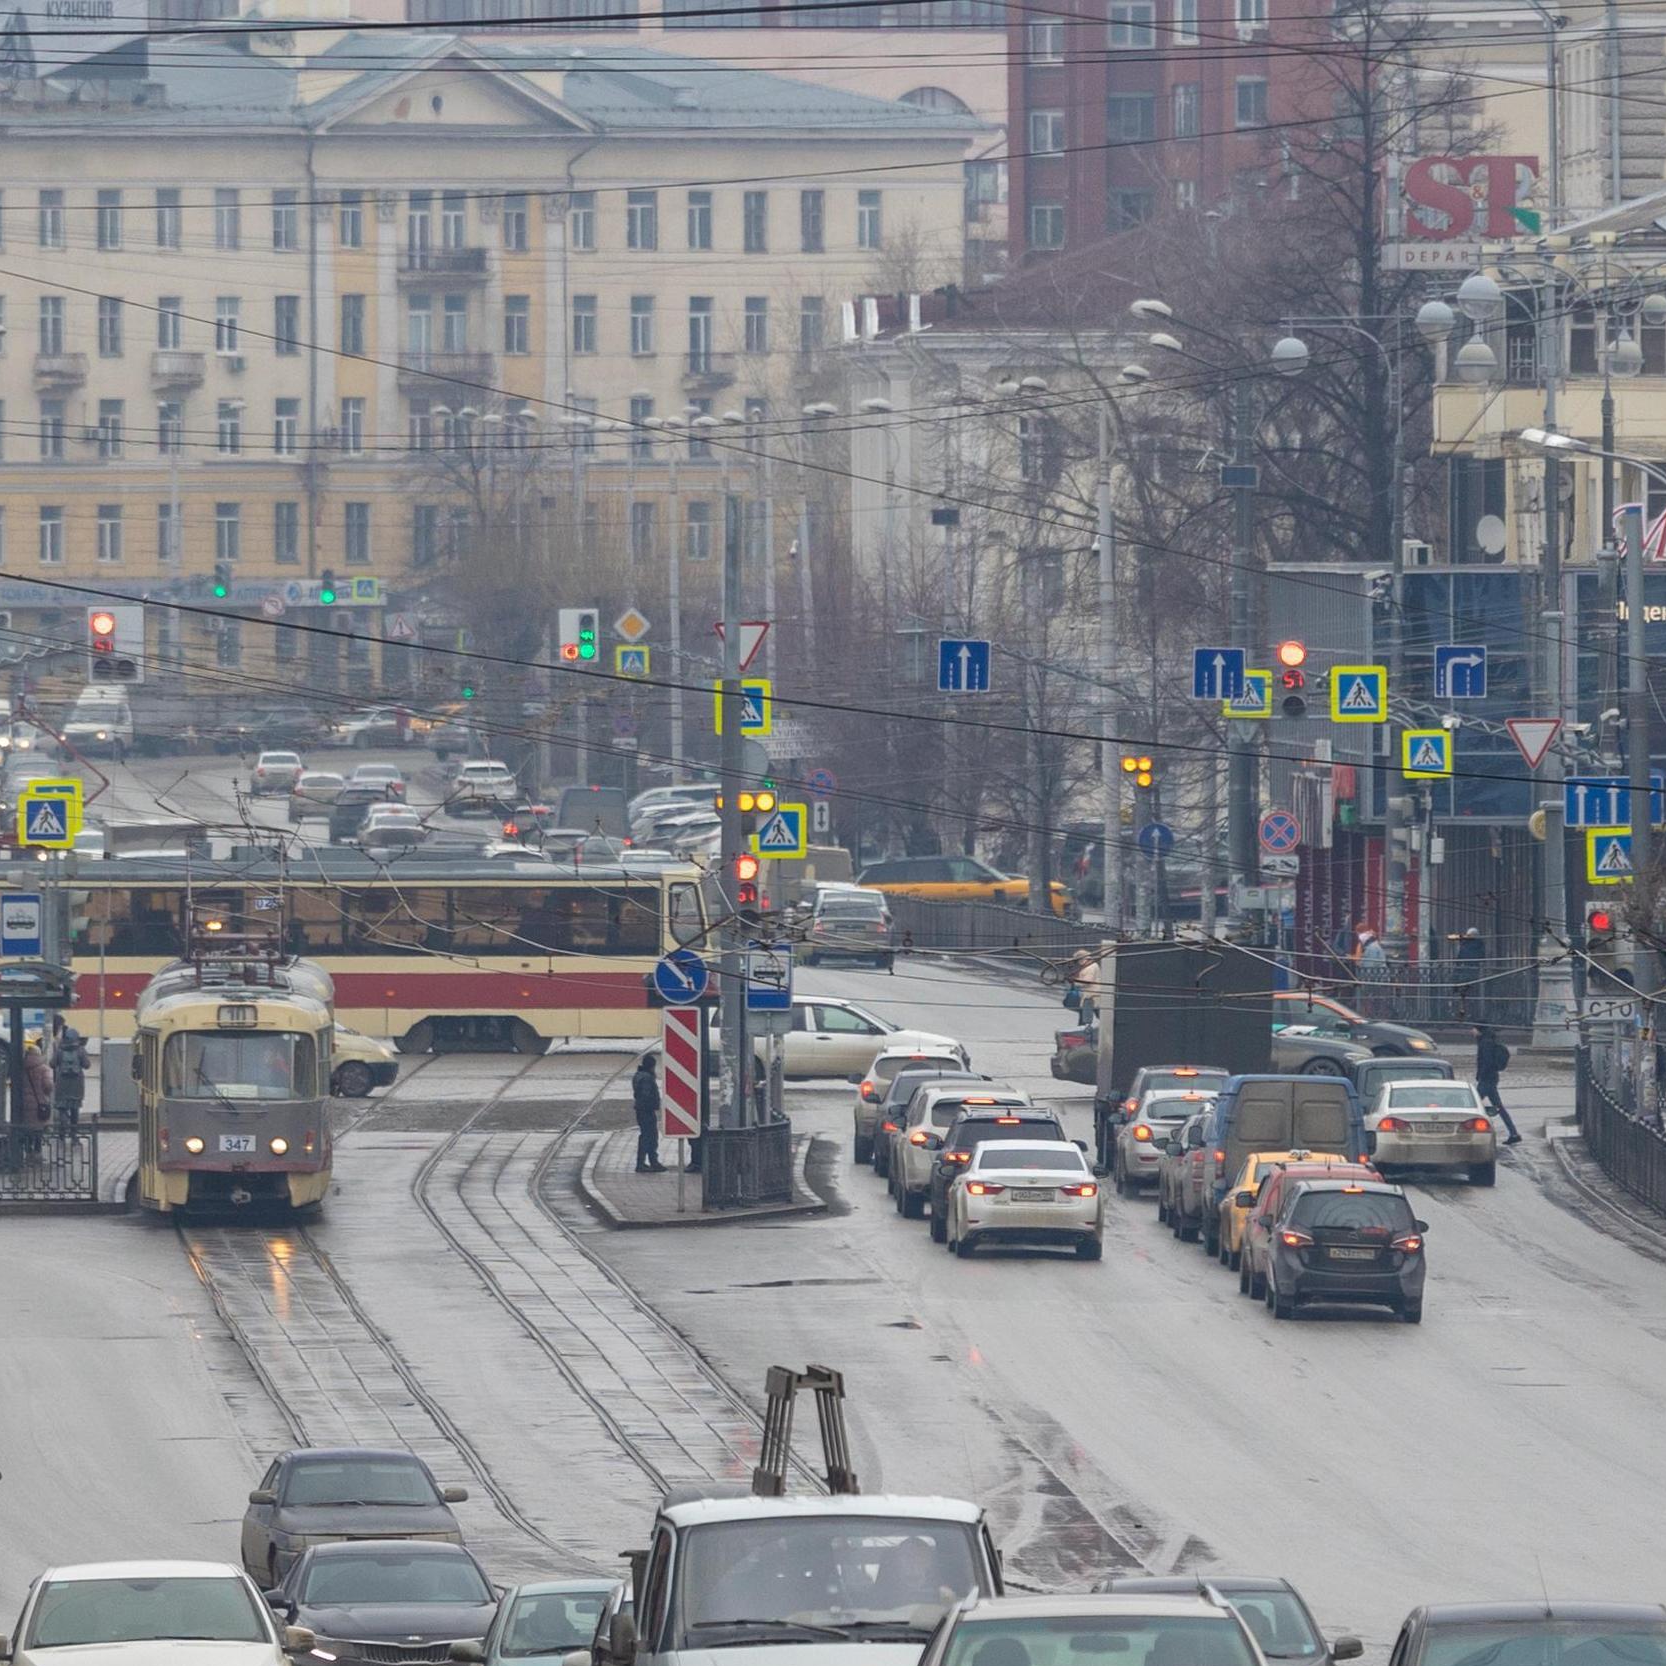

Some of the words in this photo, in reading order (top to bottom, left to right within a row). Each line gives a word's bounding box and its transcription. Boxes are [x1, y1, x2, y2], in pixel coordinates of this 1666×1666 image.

[46, 1, 114, 19] КУЗНЕЦОВ
[1405, 250, 1470, 263] DEPAR
[1589, 1001, 1633, 1017] СТО
[225, 1139, 250, 1152] 347
